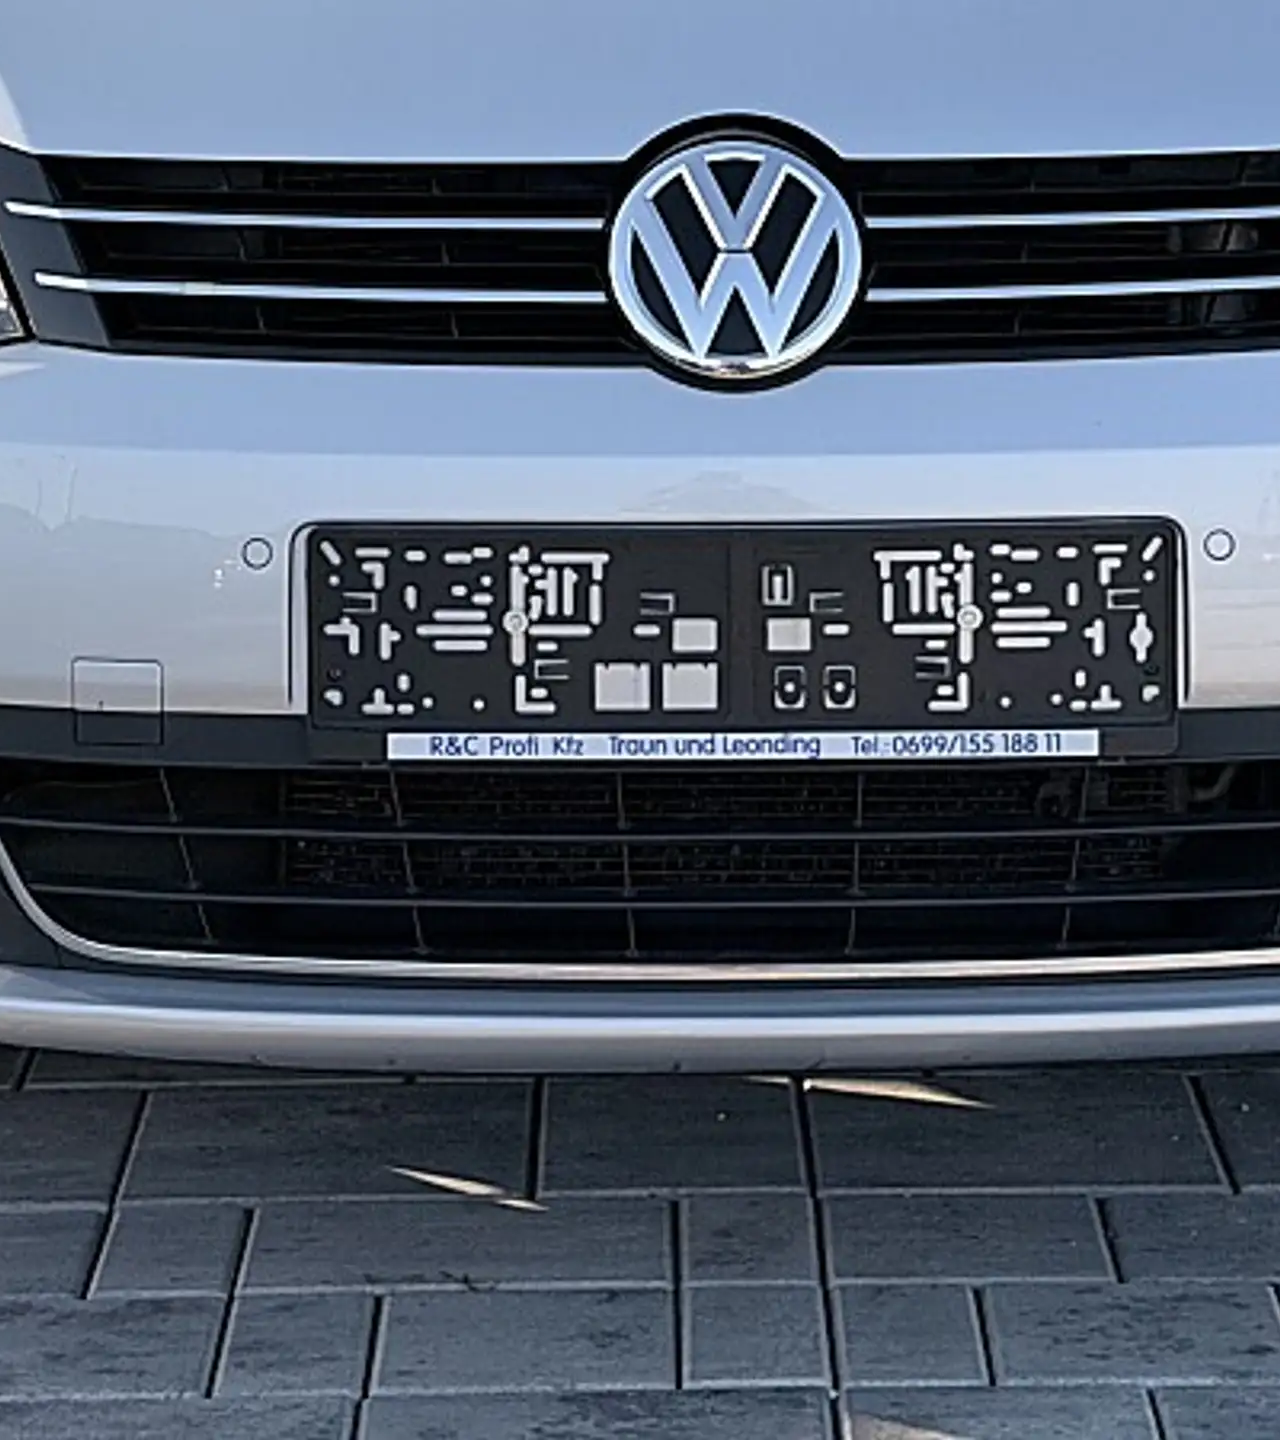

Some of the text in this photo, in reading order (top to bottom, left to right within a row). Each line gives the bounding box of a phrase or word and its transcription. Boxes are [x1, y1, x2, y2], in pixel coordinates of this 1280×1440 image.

[612, 143, 860, 376] VW
[428, 735, 479, 757] R&C
[489, 734, 539, 757] Profi
[552, 735, 585, 757] Kfz
[608, 735, 668, 756] Traun
[674, 733, 715, 756] und
[722, 733, 822, 759] Leonding
